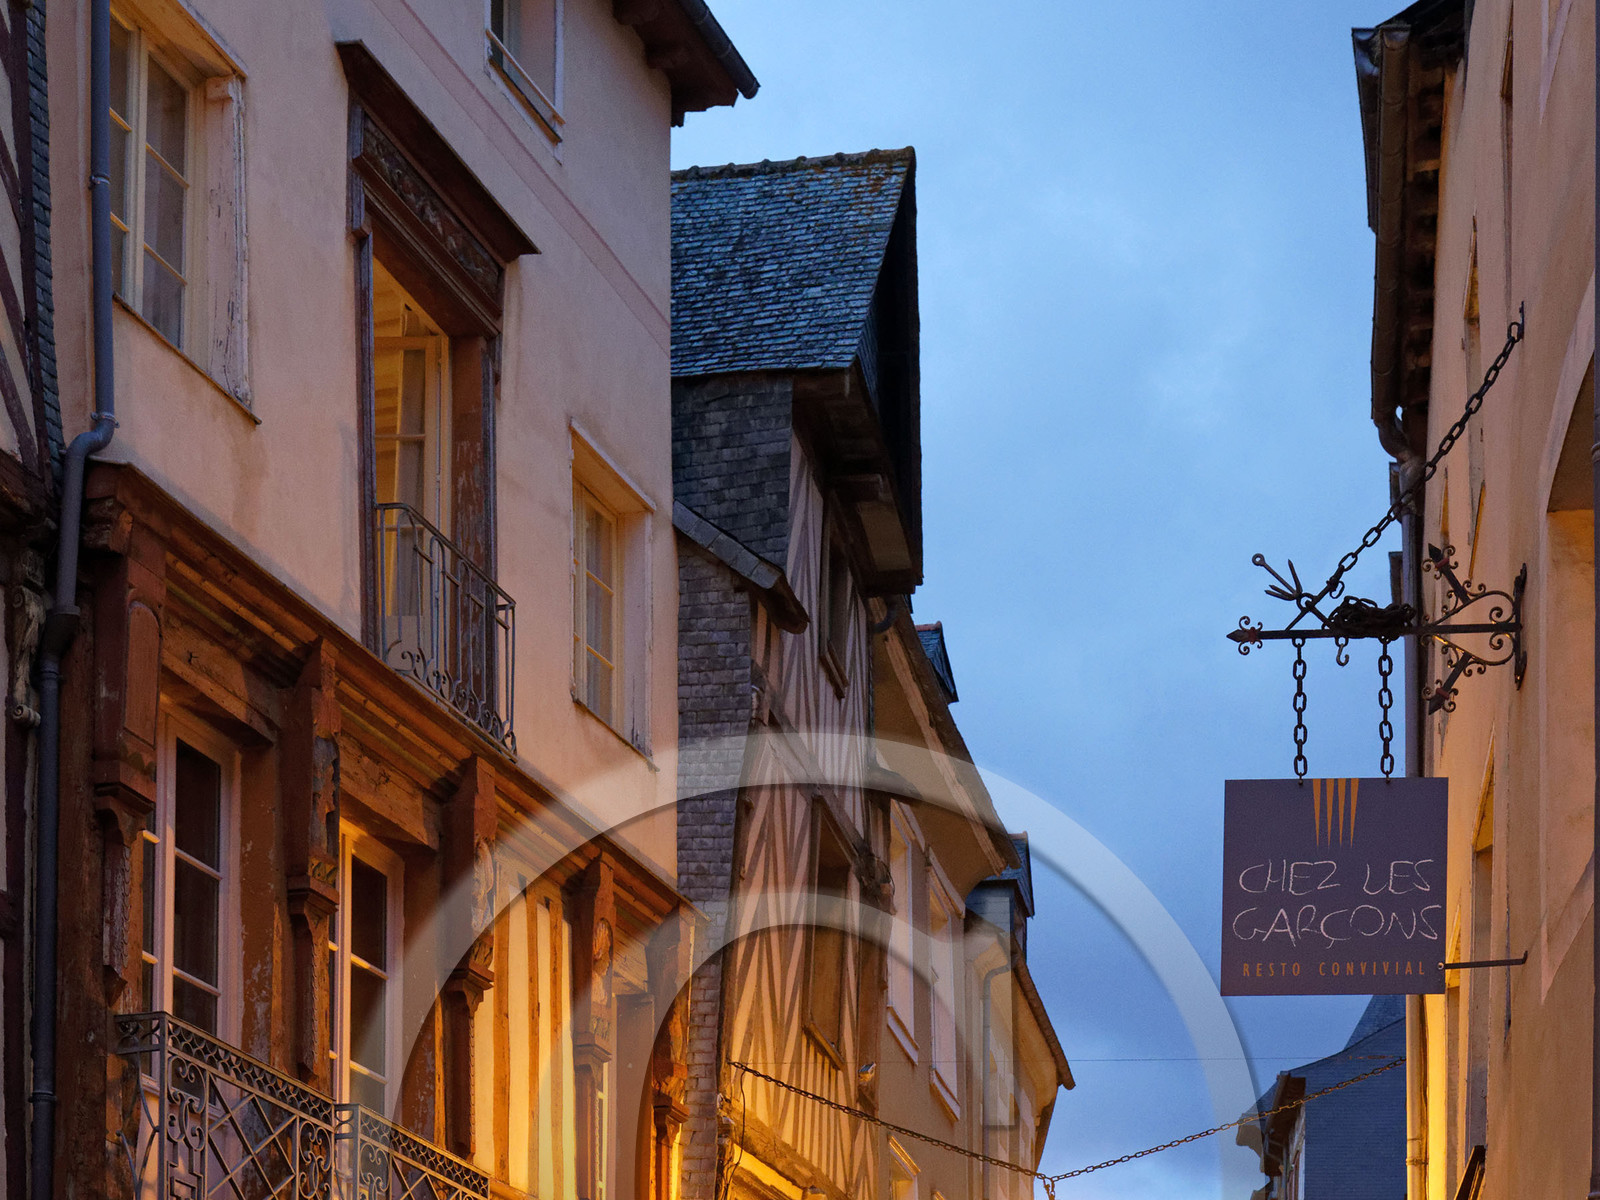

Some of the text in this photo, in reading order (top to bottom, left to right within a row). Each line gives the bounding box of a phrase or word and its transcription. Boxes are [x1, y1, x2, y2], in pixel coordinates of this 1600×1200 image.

[1239, 859, 1434, 895] CHEZ LES
[1232, 904, 1442, 949] GARÇONS
[1243, 961, 1425, 977] RESTO CONVIVIAL
